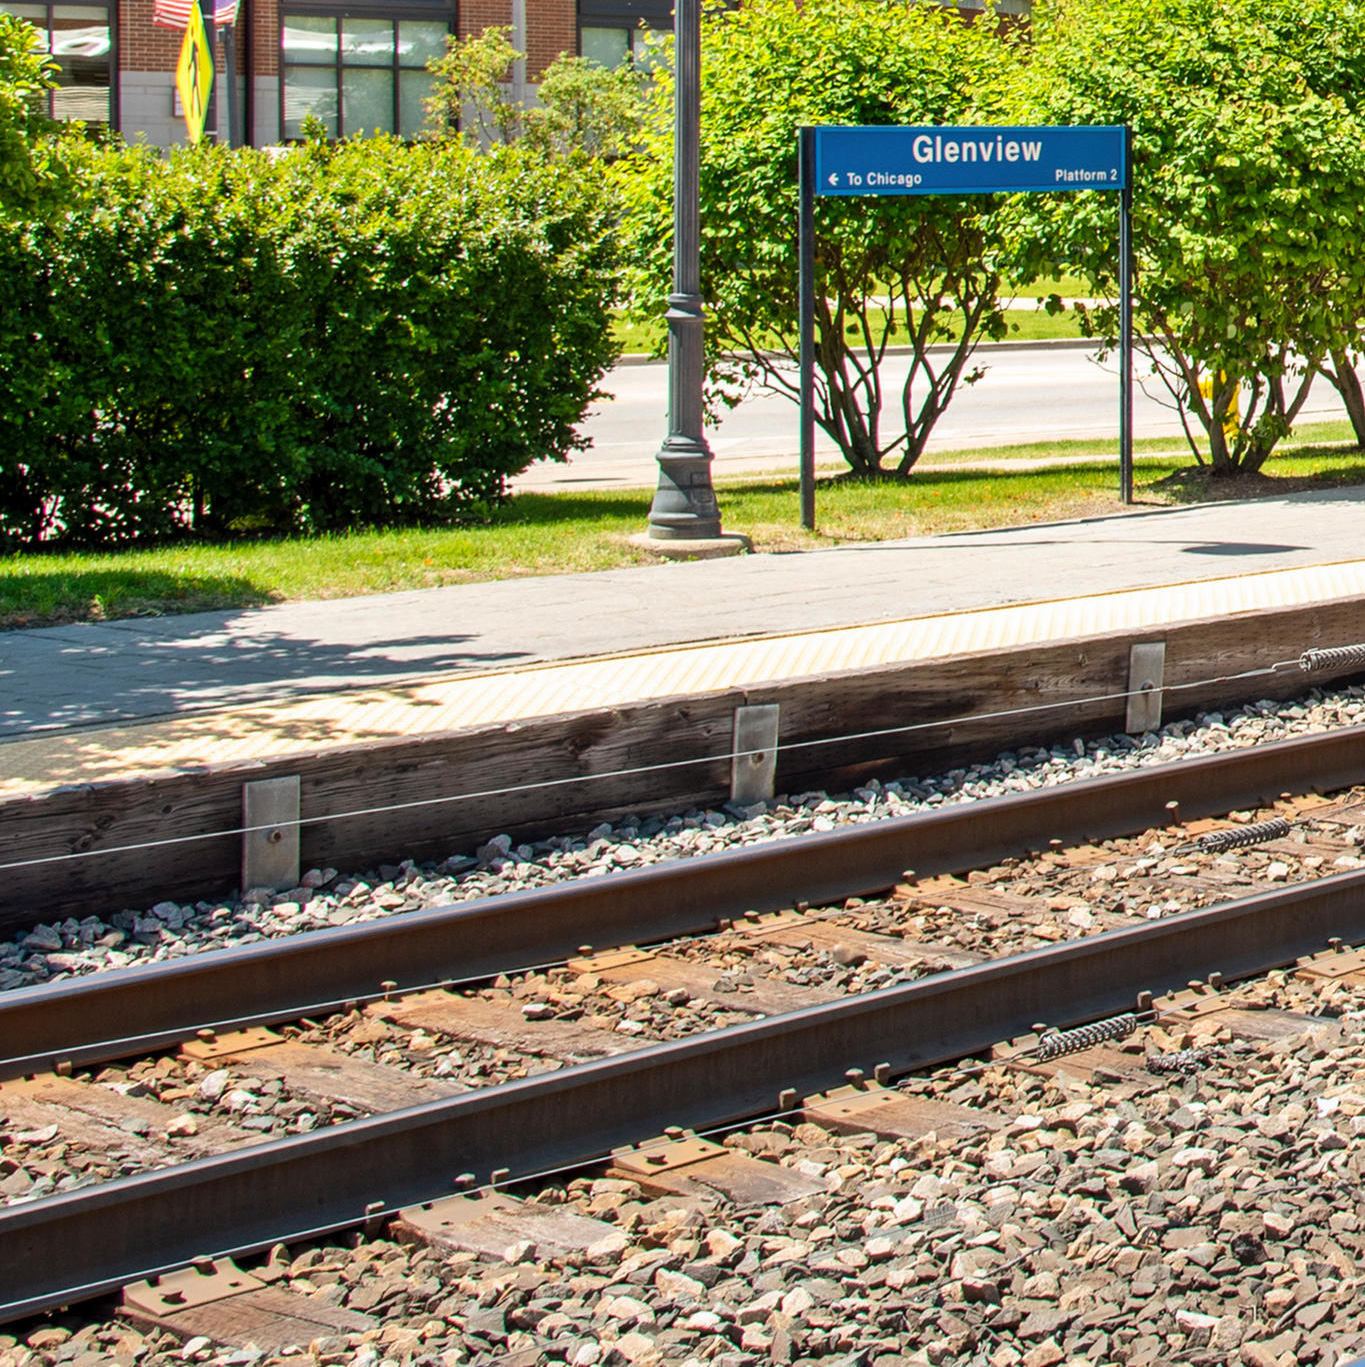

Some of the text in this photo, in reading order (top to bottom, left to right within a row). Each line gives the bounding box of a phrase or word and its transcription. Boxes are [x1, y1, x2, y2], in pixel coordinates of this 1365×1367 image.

[912, 135, 1042, 164] Glenview
[847, 171, 922, 188] To Chicago
[1055, 169, 1118, 182] Platform 2
